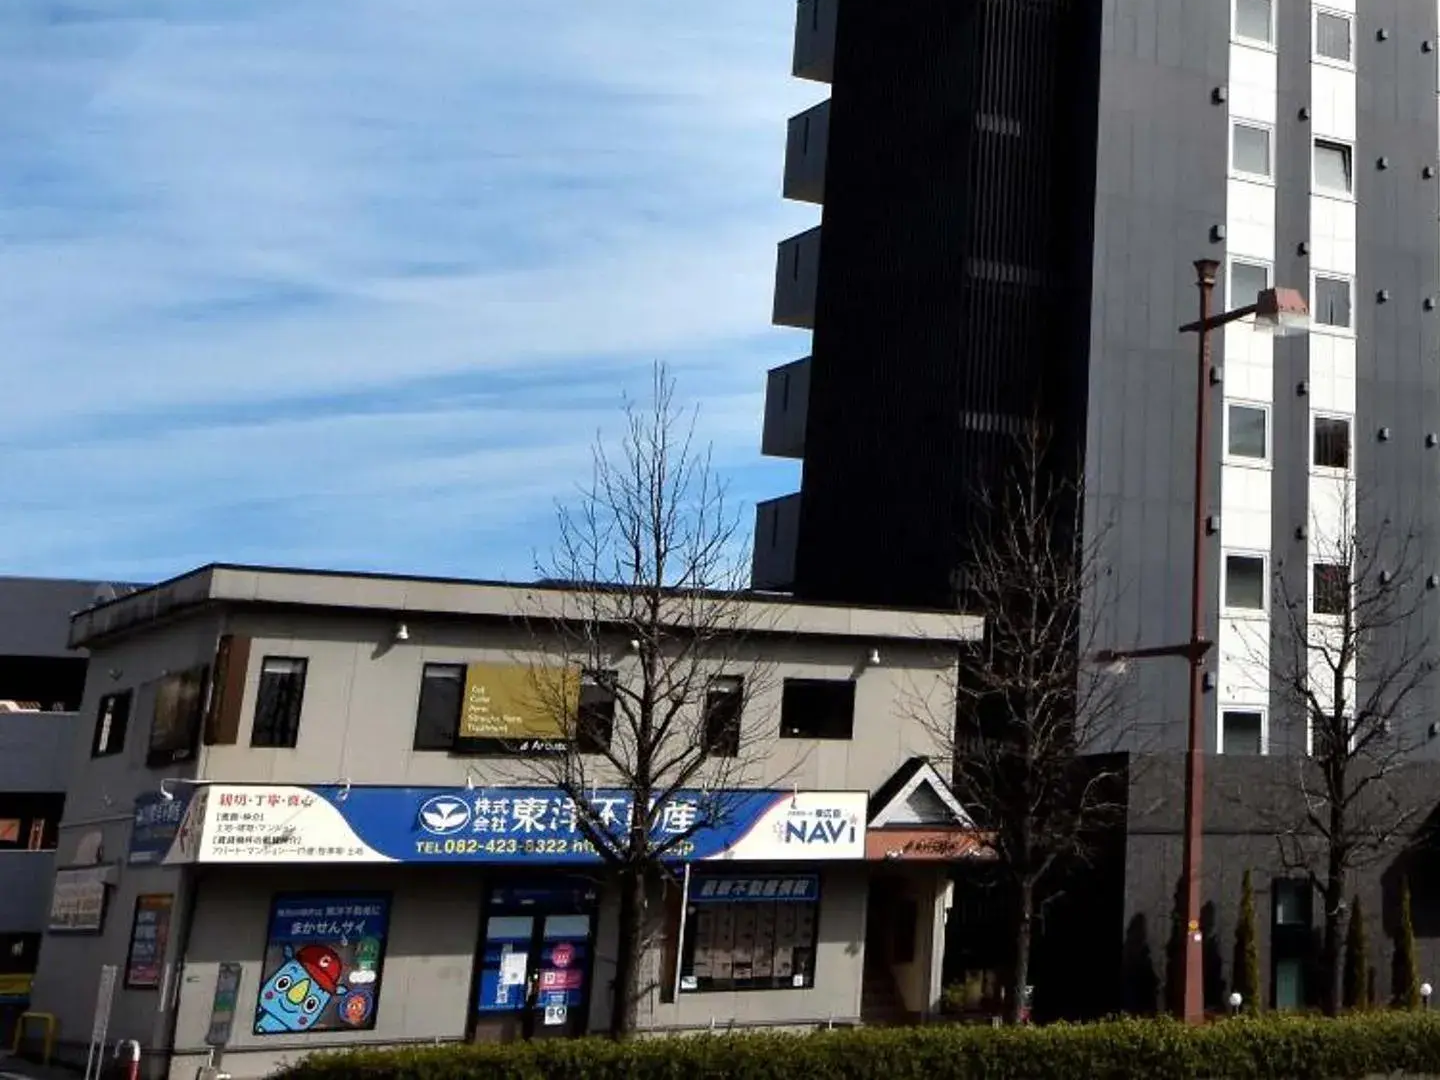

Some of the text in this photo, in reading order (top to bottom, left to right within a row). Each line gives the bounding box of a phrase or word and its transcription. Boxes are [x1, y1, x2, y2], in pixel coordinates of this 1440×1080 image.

[291, 920, 366, 935] まかせんサイ
